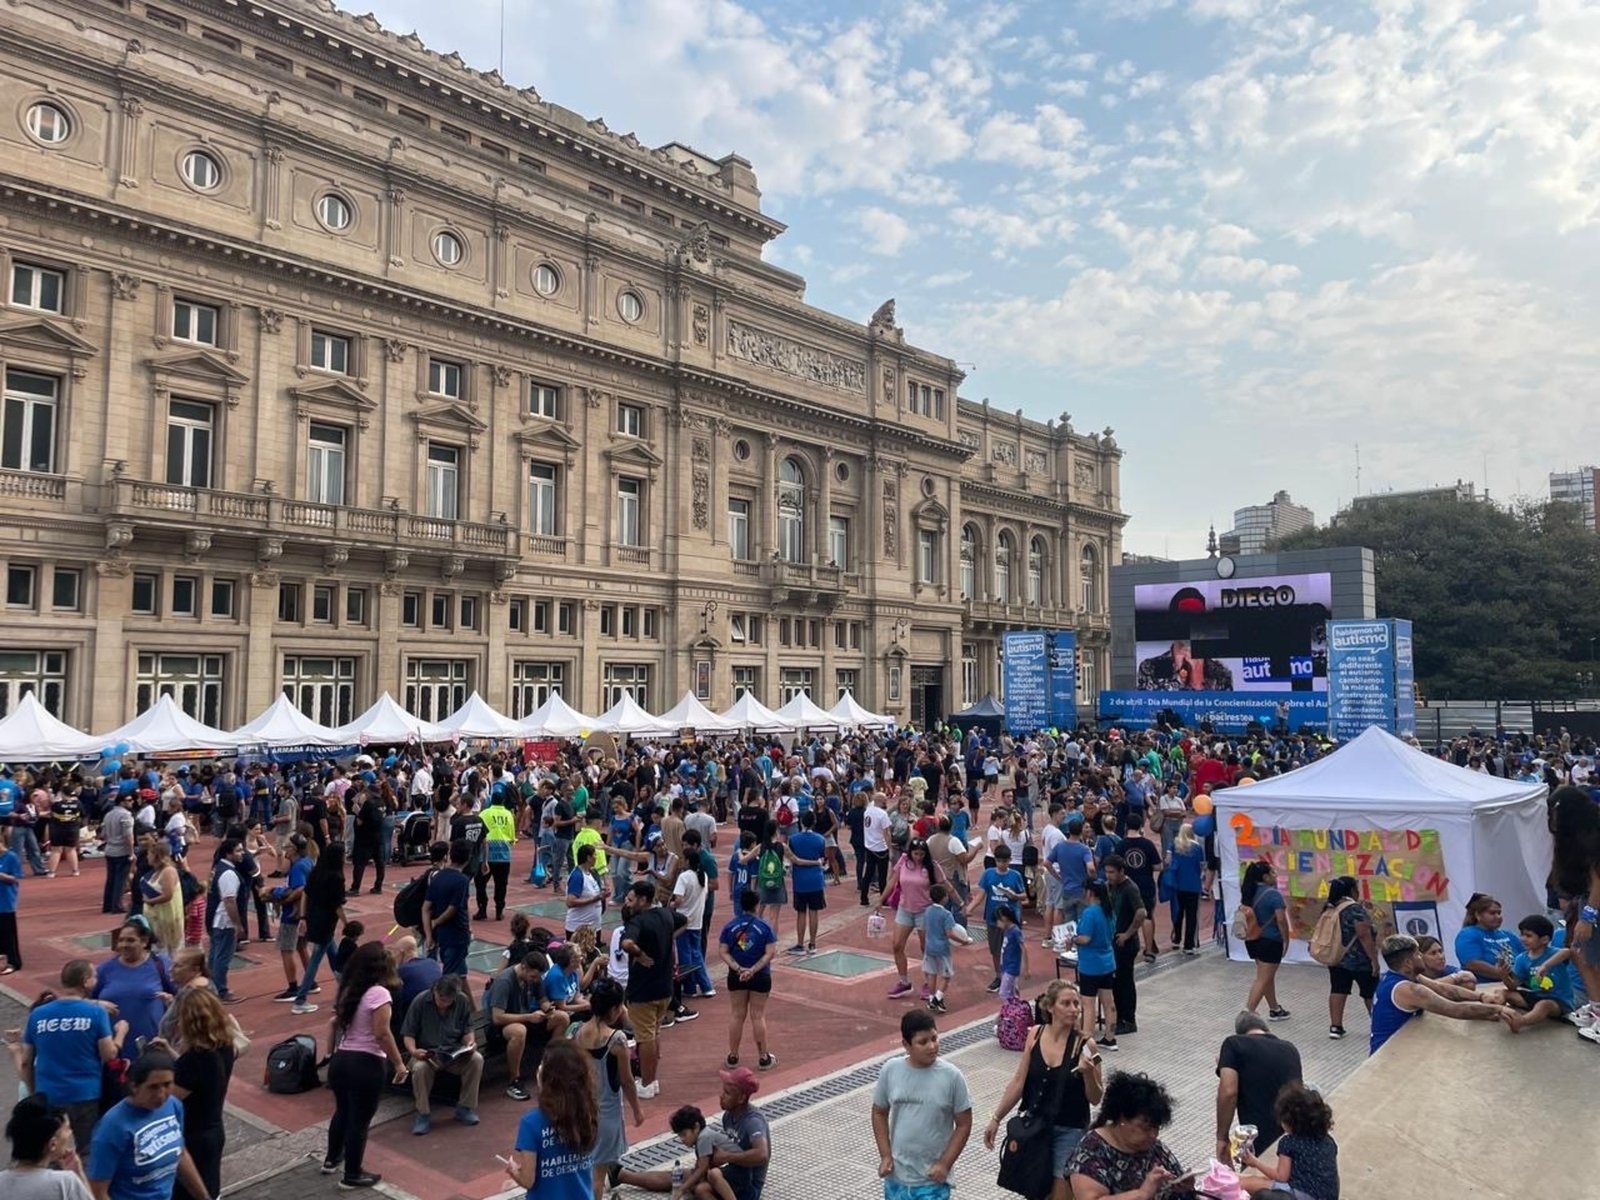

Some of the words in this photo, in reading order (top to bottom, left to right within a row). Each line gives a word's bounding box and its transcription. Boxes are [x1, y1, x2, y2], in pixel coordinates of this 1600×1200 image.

[1221, 585, 1295, 608] DIEGO
[1334, 634, 1386, 646] autismo
[1161, 698, 1193, 706] Mundial
[1214, 699, 1278, 707] Concientización
[1229, 812, 1261, 846] 2
[737, 868, 747, 884] 10
[541, 1168, 555, 1178] DE
